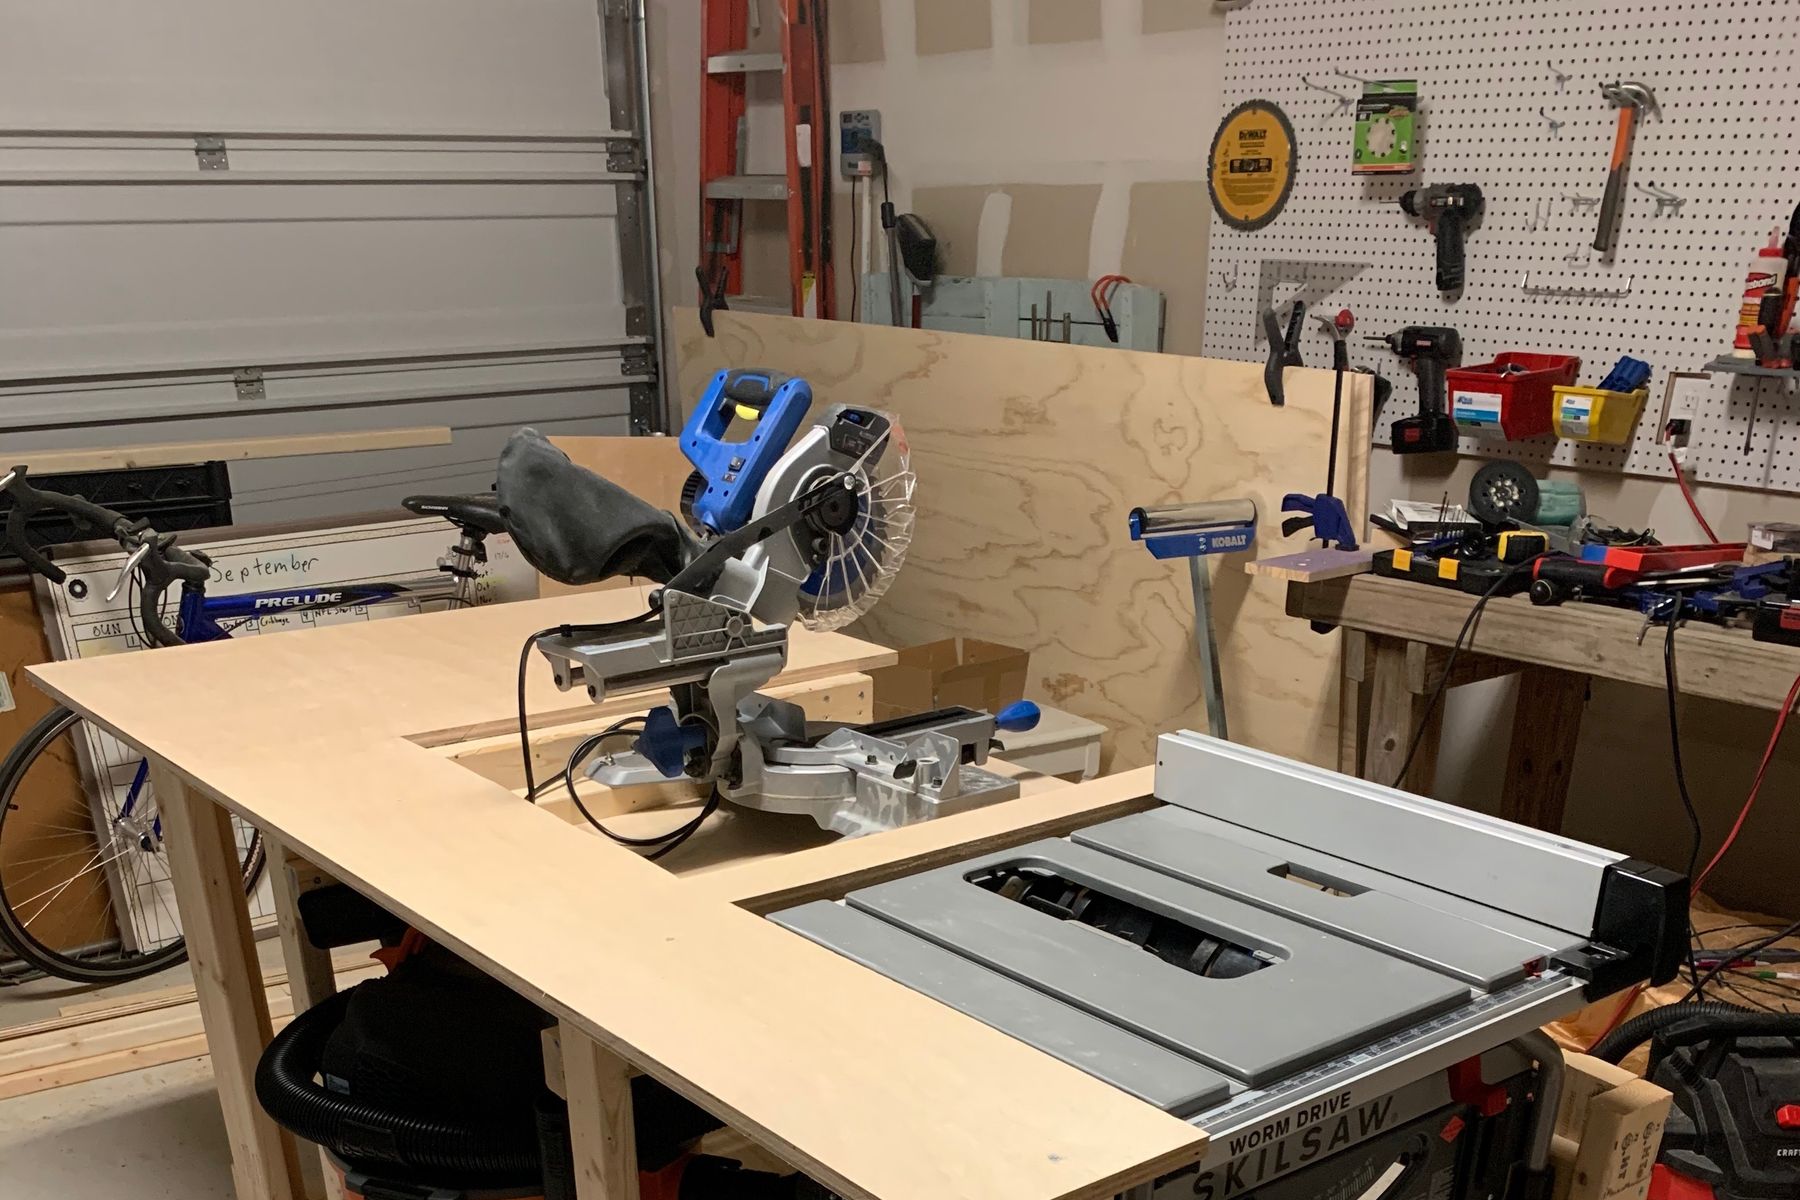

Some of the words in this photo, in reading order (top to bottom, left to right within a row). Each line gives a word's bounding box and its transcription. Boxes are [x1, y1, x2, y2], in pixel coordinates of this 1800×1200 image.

[1212, 534, 1247, 548] KOBALT
[211, 554, 319, 584] September
[254, 592, 343, 609] PRELUDE
[1229, 1116, 1290, 1156] WORM
[1296, 1091, 1352, 1129] DRIVE
